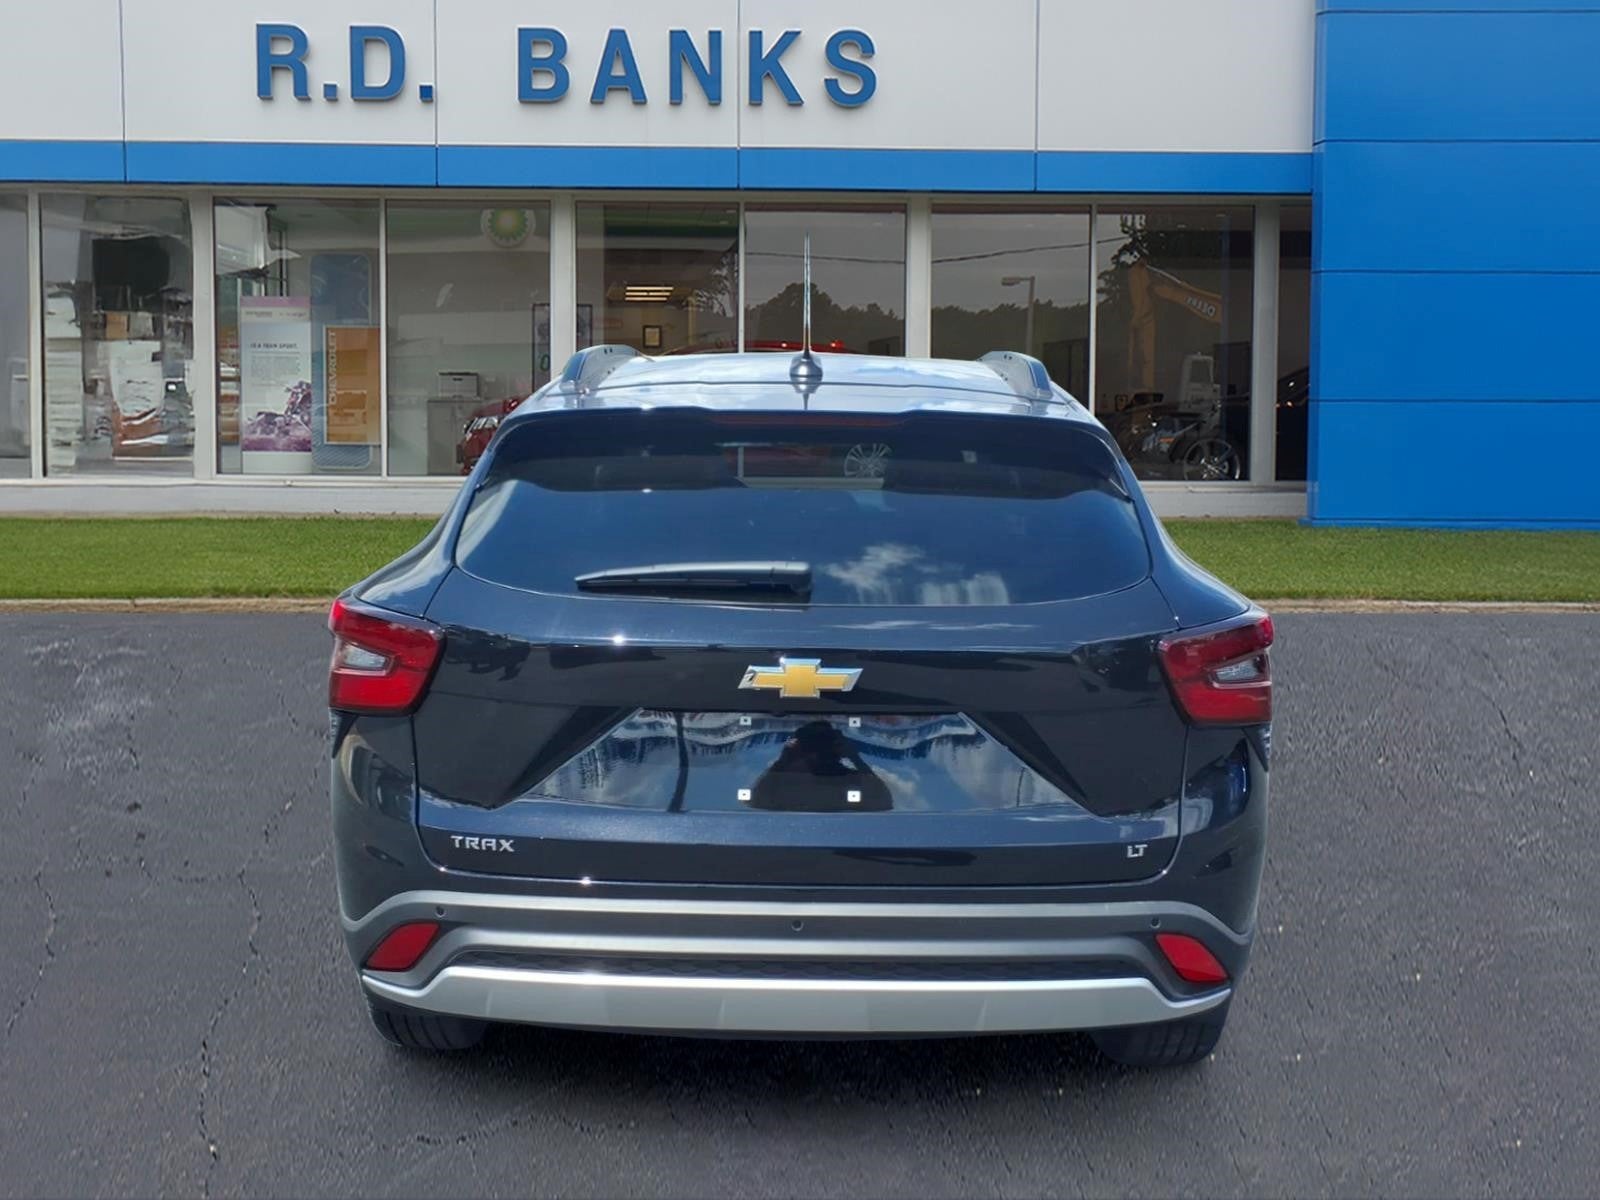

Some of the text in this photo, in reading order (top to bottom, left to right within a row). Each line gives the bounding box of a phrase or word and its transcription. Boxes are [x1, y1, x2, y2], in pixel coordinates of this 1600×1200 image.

[256, 23, 877, 108] R.D. BANKS
[450, 835, 515, 852] TRAX
[1127, 844, 1148, 858] LT
